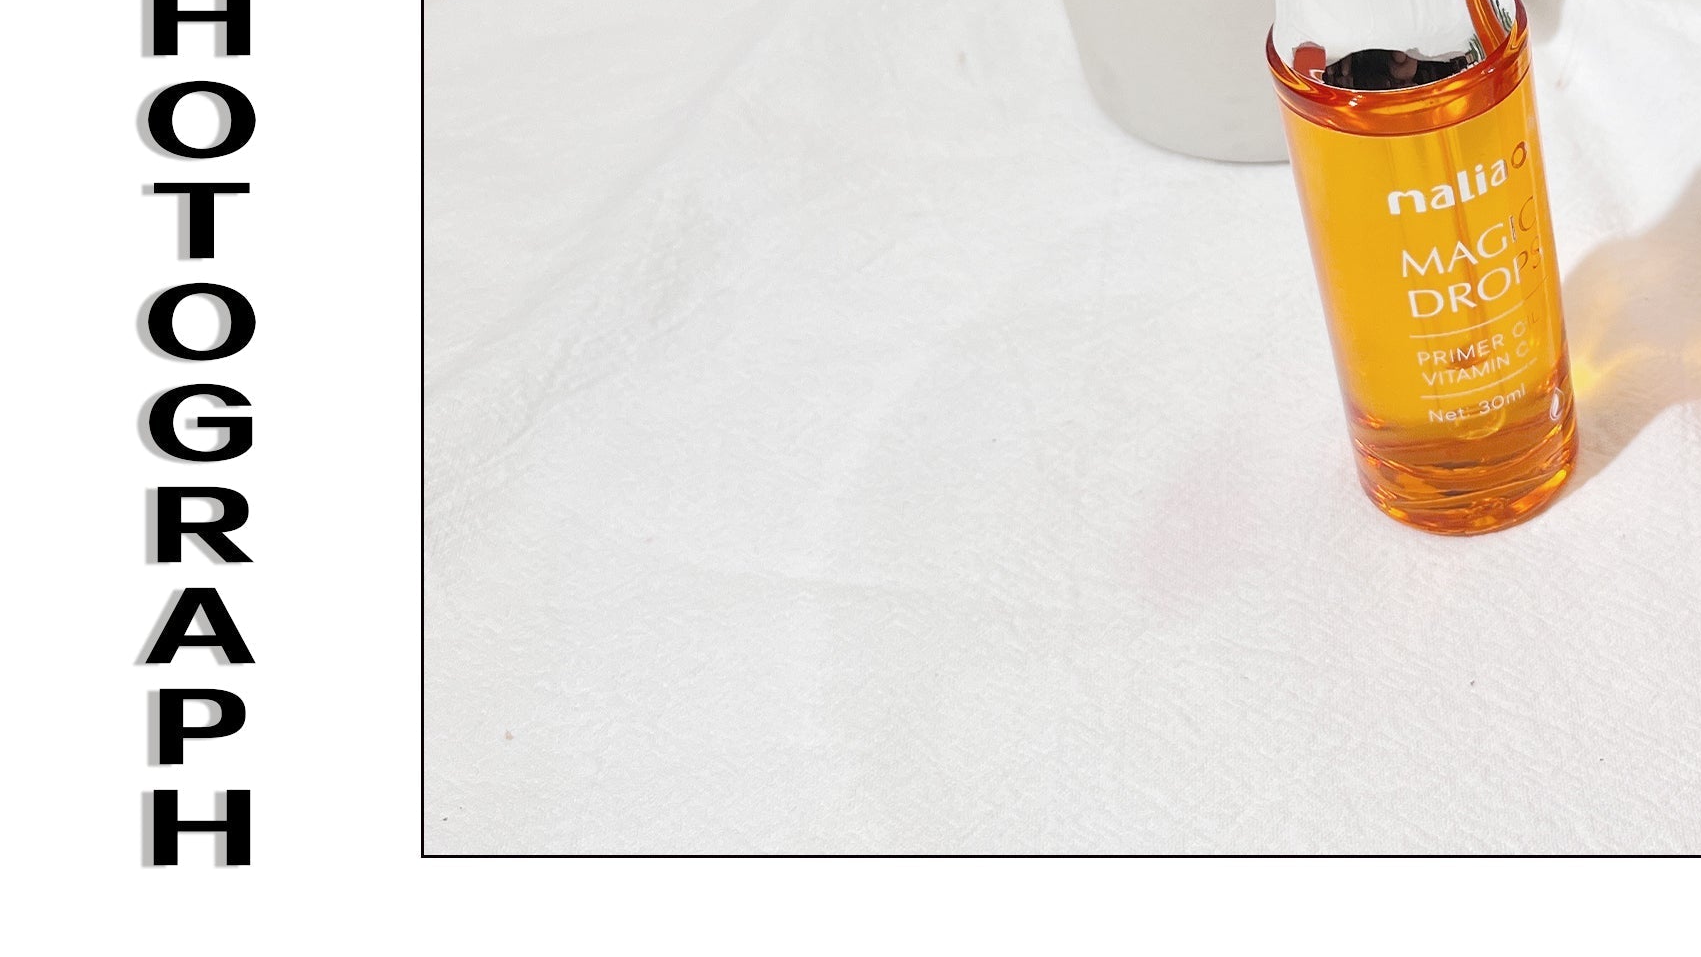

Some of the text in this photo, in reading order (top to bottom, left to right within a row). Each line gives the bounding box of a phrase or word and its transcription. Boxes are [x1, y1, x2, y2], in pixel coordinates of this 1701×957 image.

[1387, 141, 1528, 215] maliao
[1402, 196, 1539, 278] MAGIC
[1416, 333, 1505, 367] PRIMER
[1421, 340, 1529, 386] VITAMIN C
[1478, 383, 1526, 415] 30ml
